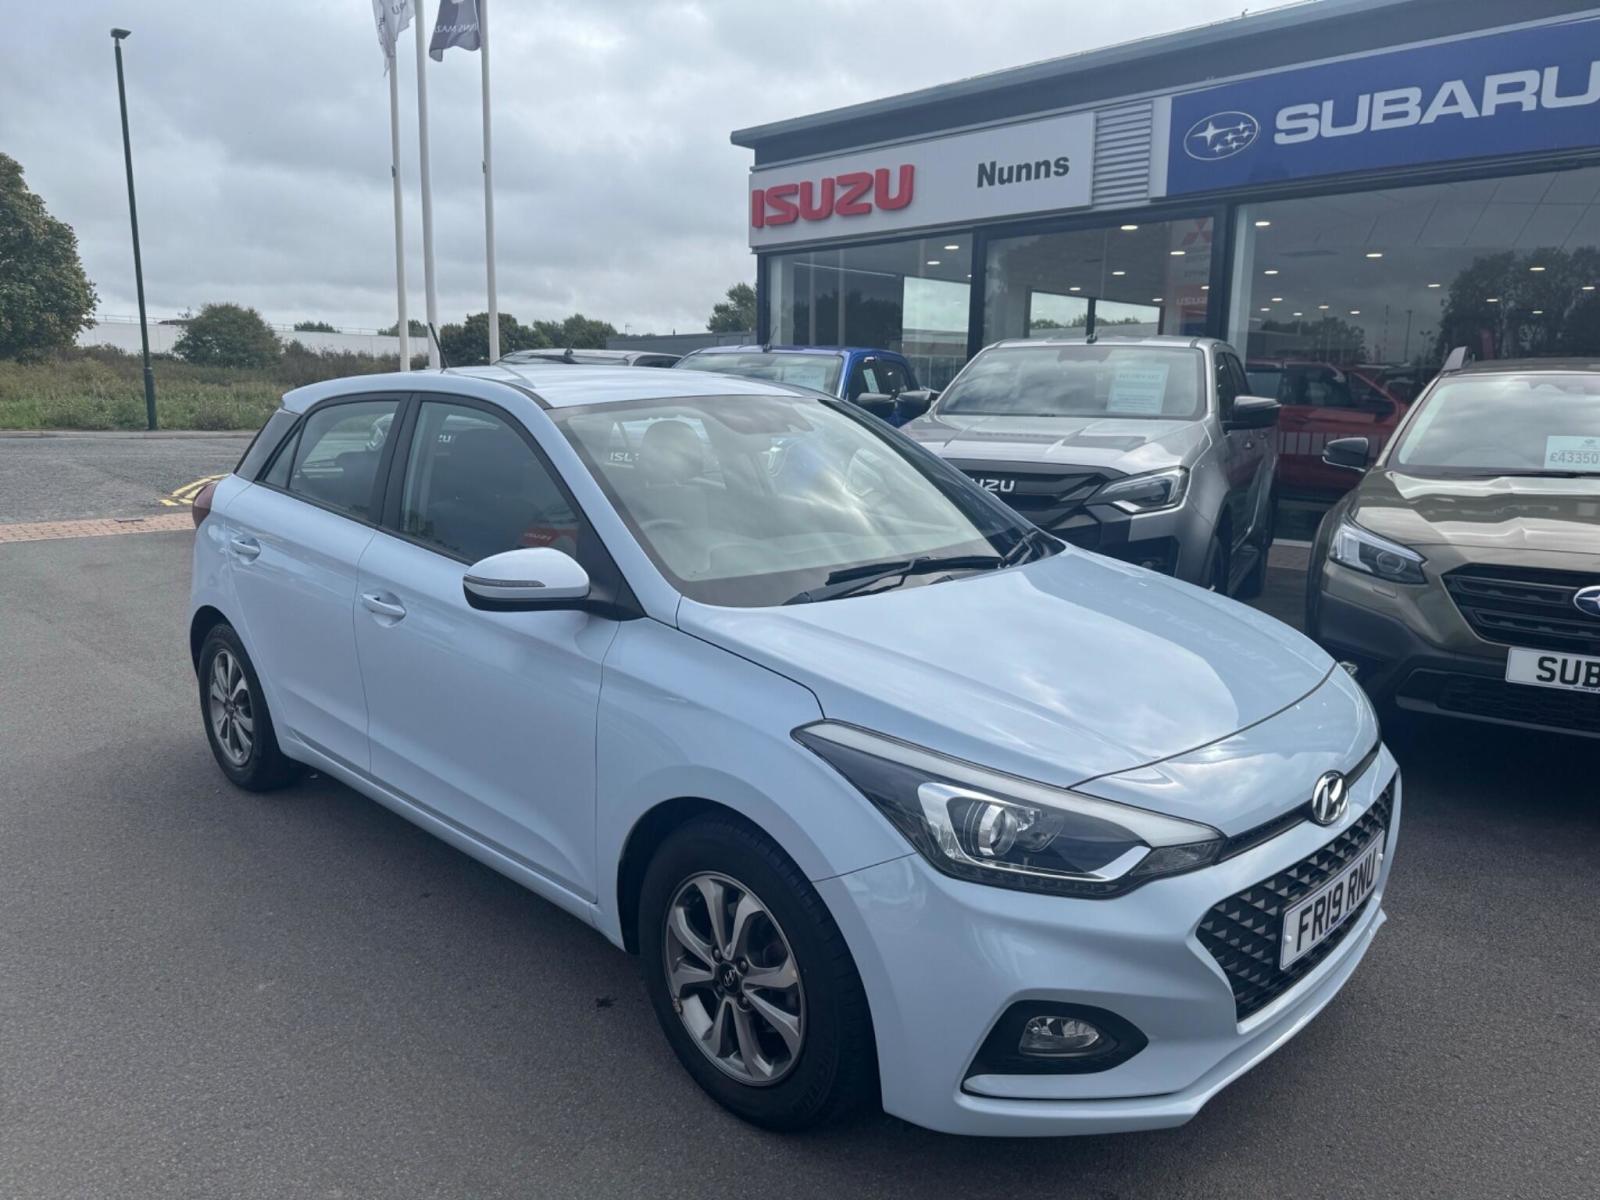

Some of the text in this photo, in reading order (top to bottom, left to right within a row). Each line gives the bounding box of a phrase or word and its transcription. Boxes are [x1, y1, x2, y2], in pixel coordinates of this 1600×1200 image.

[1274, 61, 1600, 145] SUBARU
[752, 164, 914, 229] ISUZU
[977, 157, 1069, 188] Nunns
[1536, 656, 1600, 688] SUB
[1296, 847, 1376, 952] FR19 RNU
